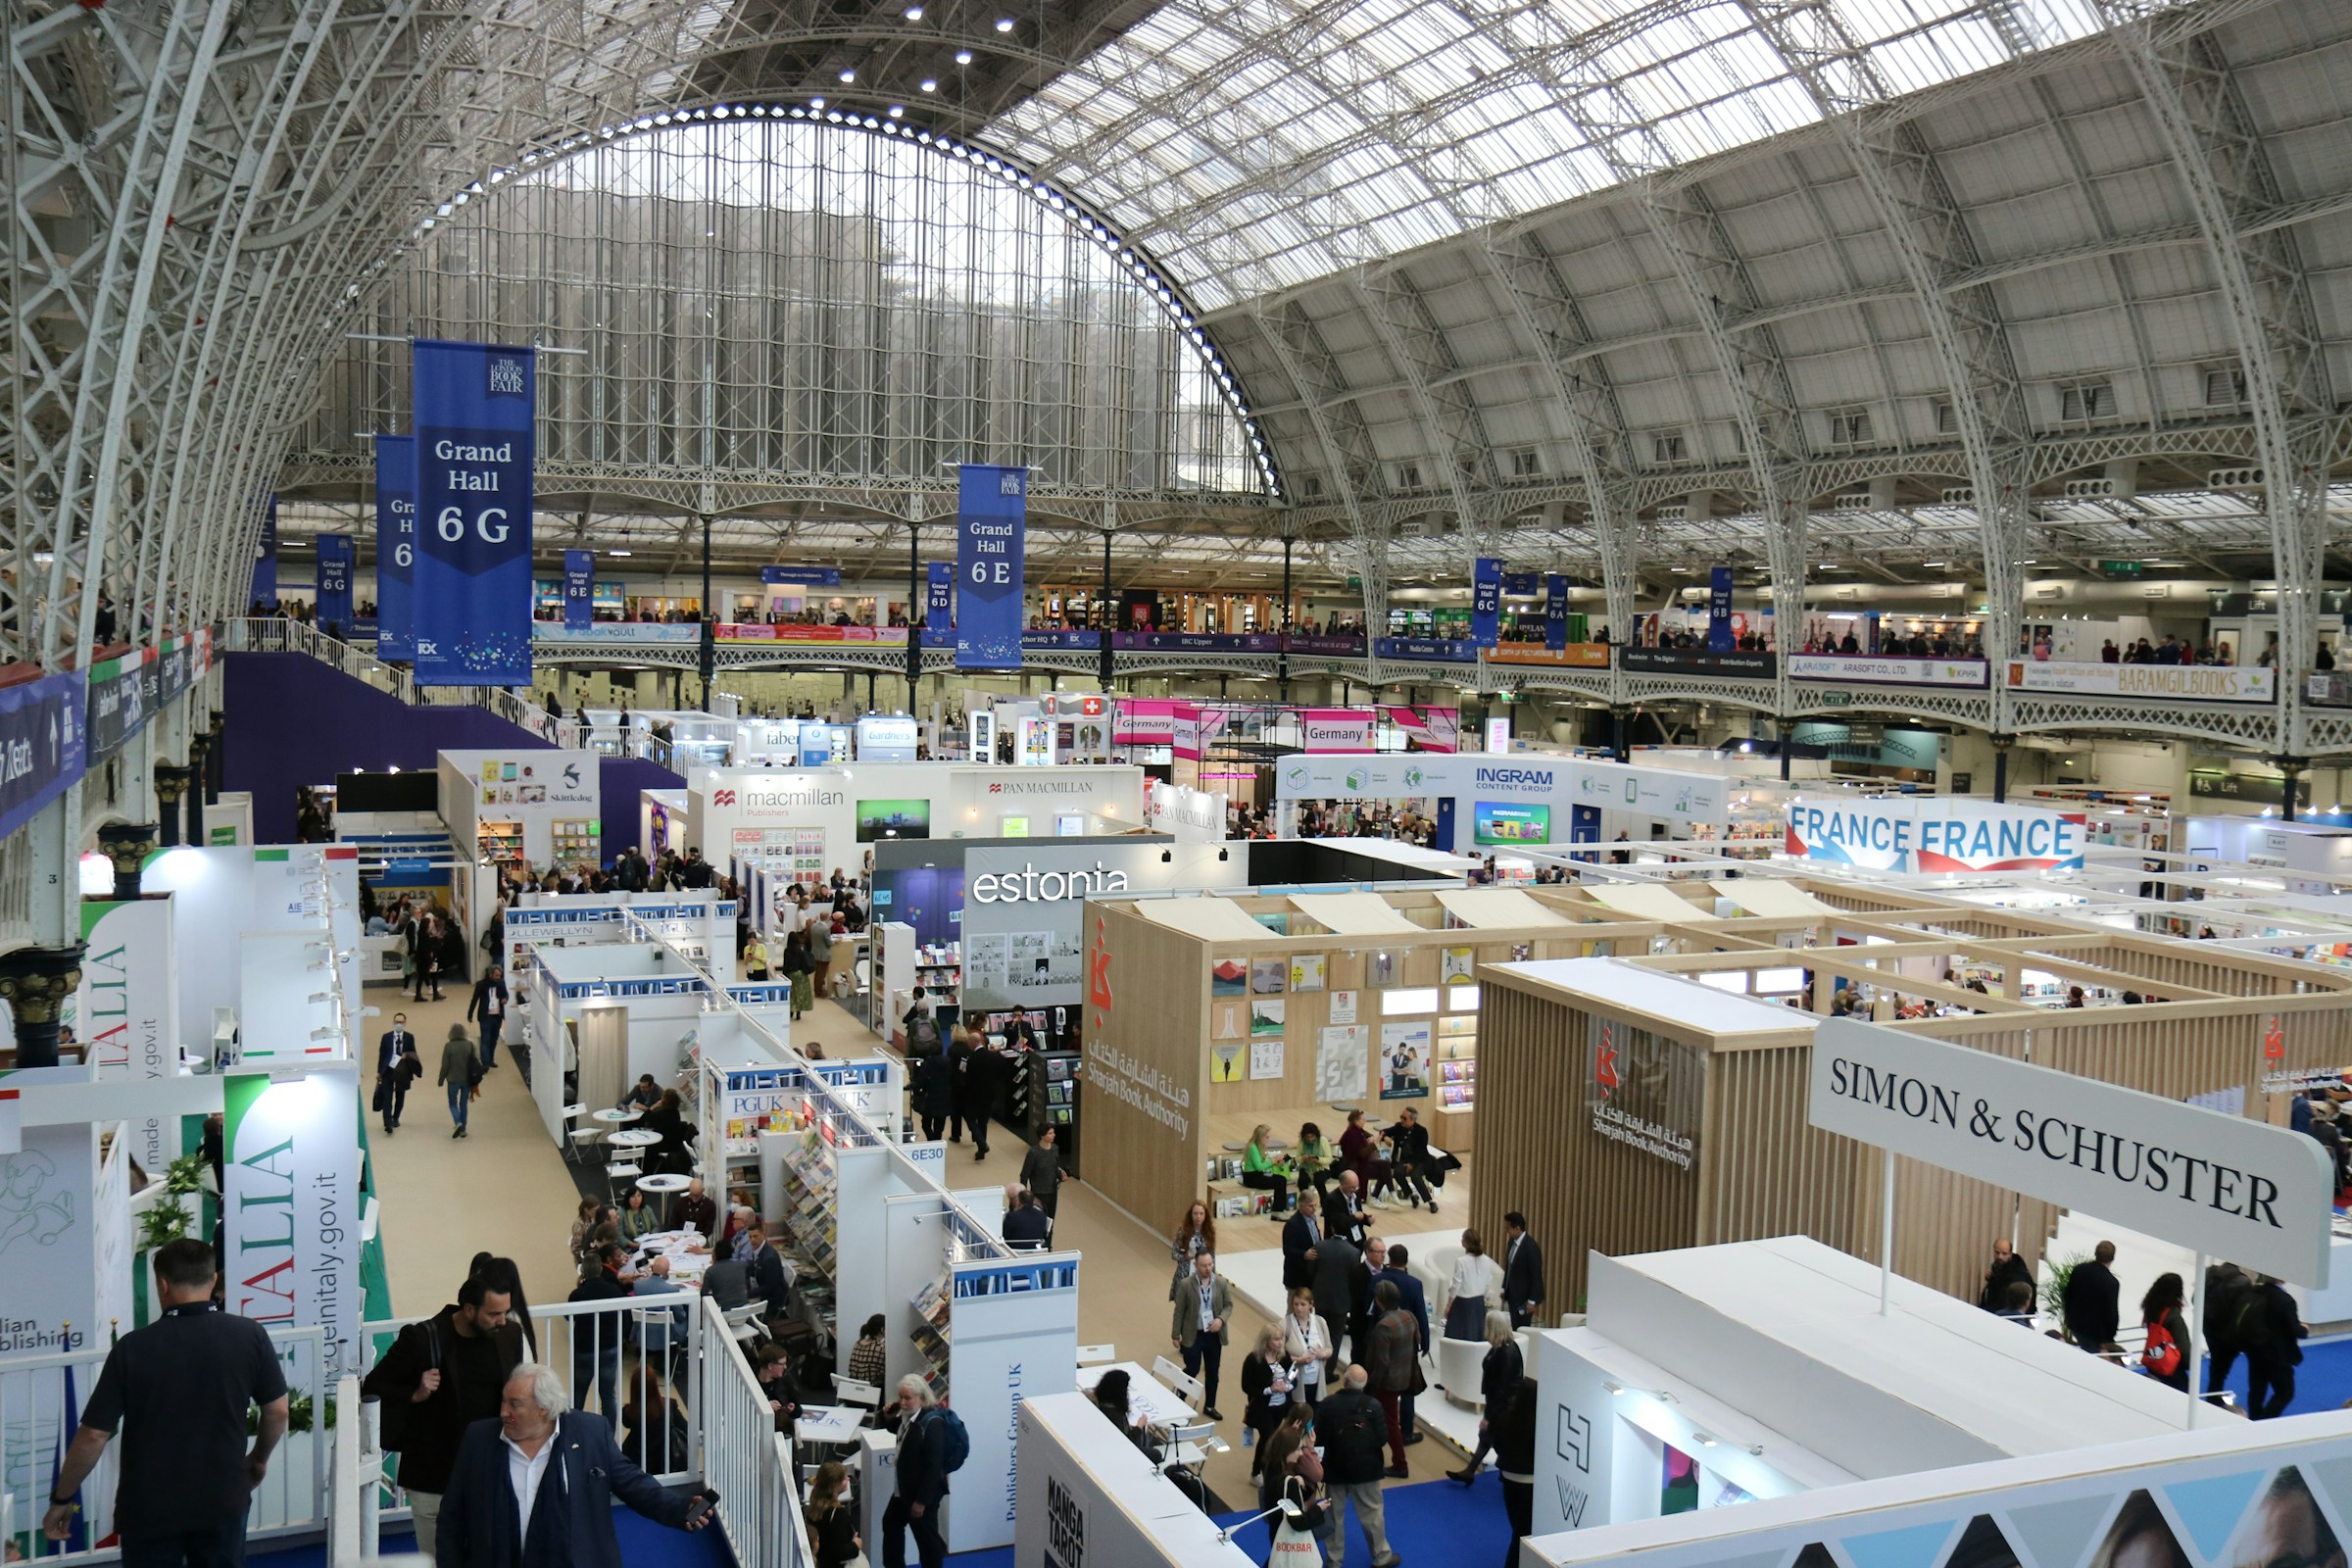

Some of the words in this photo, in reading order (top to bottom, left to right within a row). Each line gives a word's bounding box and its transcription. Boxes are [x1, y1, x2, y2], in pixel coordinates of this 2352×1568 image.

[490, 371, 523, 383] BOOK
[490, 381, 523, 393] FAIR
[435, 440, 513, 464] Grand
[449, 470, 500, 492] Hall
[391, 500, 415, 514] Gra
[438, 507, 465, 542] 6
[477, 508, 511, 544] G
[970, 522, 1013, 536] Grand
[977, 540, 1005, 554] Hall
[395, 543, 413, 567] 6
[971, 562, 987, 584] 6
[994, 563, 1010, 584] E
[323, 579, 332, 590] 6
[335, 579, 345, 591] G
[570, 587, 577, 597] 6
[579, 587, 587, 597] E
[932, 598, 938, 607] 6
[940, 598, 948, 607] D
[1478, 600, 1485, 611] 6
[1486, 600, 1494, 612] C
[2248, 599, 2266, 612] Lift
[1549, 611, 1555, 619] 6
[1556, 611, 1563, 619] A
[1713, 608, 1719, 617] 6
[1721, 609, 1727, 617] B
[417, 643, 437, 655] RX
[1182, 637, 1193, 646] IRC
[1194, 638, 1213, 647] Upper
[1802, 662, 1837, 671] ARASOFT
[1842, 663, 1876, 674] ARASOFT
[1892, 665, 1908, 675] LTD.
[1122, 719, 1172, 730] Germany
[868, 731, 910, 741] Gardners
[1309, 727, 1363, 742] Germany
[1476, 768, 1553, 785] INGRAM
[1004, 782, 1025, 795] PAN
[1027, 781, 1093, 794] MACMILLAN
[1476, 783, 1518, 792] CONTENT
[1521, 784, 1553, 793] GROUP
[2221, 781, 2238, 793] Lift
[551, 794, 593, 803] Skittledog
[747, 788, 844, 806] macmillan
[1161, 807, 1174, 820] PAN
[1175, 807, 1217, 831] MACMILLAN
[1791, 806, 1911, 855] FRANCE
[1922, 818, 2075, 858] FRANCE
[973, 860, 1128, 904] estonia
[516, 926, 593, 937] LLEWELLYN
[734, 1095, 784, 1113] PGUK
[1088, 1061, 1119, 1096] Sharjah
[1119, 1081, 1143, 1108] Book
[1143, 1093, 1189, 1141] Authority
[1593, 1118, 1625, 1142] Sharjah
[1625, 1130, 1647, 1151] Book
[1647, 1139, 1691, 1171] Authority
[1831, 1056, 1961, 1130] SIMON
[1969, 1099, 2005, 1144] &
[2013, 1109, 2283, 1230] SCHUSTER
[911, 1148, 944, 1161] 6E30
[1008, 1362, 1022, 1391] UK
[1007, 1393, 1021, 1442] Group
[879, 1453, 896, 1466] PG
[1006, 1448, 1018, 1522] Publishers
[1048, 1474, 1083, 1546] MANGA
[1048, 1509, 1083, 1568] TAROT
[1276, 1542, 1312, 1553] BOOKBAR
